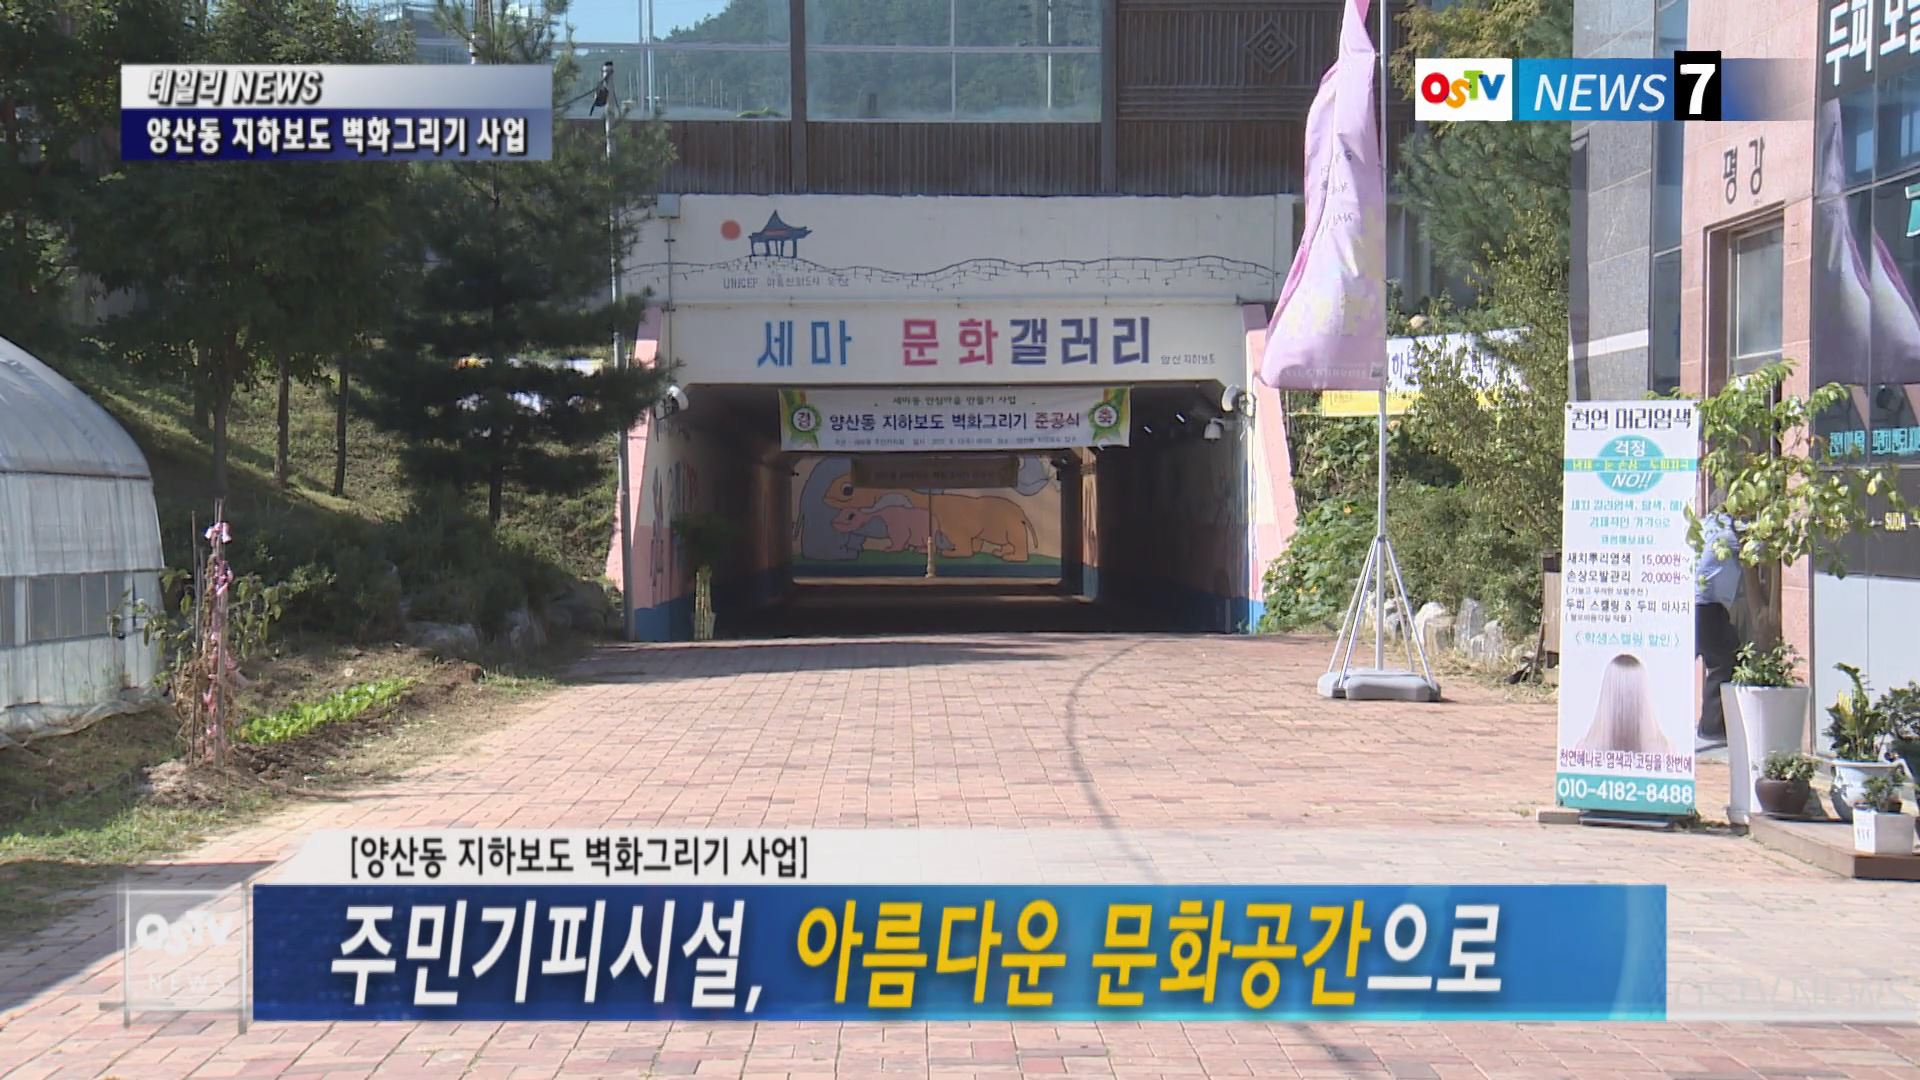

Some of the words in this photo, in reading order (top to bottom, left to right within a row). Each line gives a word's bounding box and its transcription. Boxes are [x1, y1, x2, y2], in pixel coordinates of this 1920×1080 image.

[1723, 136, 1765, 204] 평강
[757, 320, 852, 368] 세마
[829, 414, 876, 431] 양산동
[882, 414, 945, 431] 지하보도
[951, 412, 1027, 429] 벽화그리기
[1034, 411, 1080, 429] 준공식
[1571, 408, 1609, 430] 천연
[1615, 408, 1692, 430] 머리염색
[1615, 440, 1646, 457] 걱정
[1612, 472, 1653, 489] NO!!
[1567, 552, 1631, 566] 새치뿌리염색
[1567, 570, 1631, 583] 손상모발관리
[1566, 599, 1585, 611] 두피
[1624, 601, 1632, 611] &
[1637, 600, 1657, 613] 두피
[1661, 602, 1690, 614] 마사지
[1560, 749, 1603, 768] 천연헤나로
[1606, 752, 1633, 770] 염색과
[1665, 755, 1692, 773] 한번에
[1557, 777, 1693, 804] 010-4182-8488
